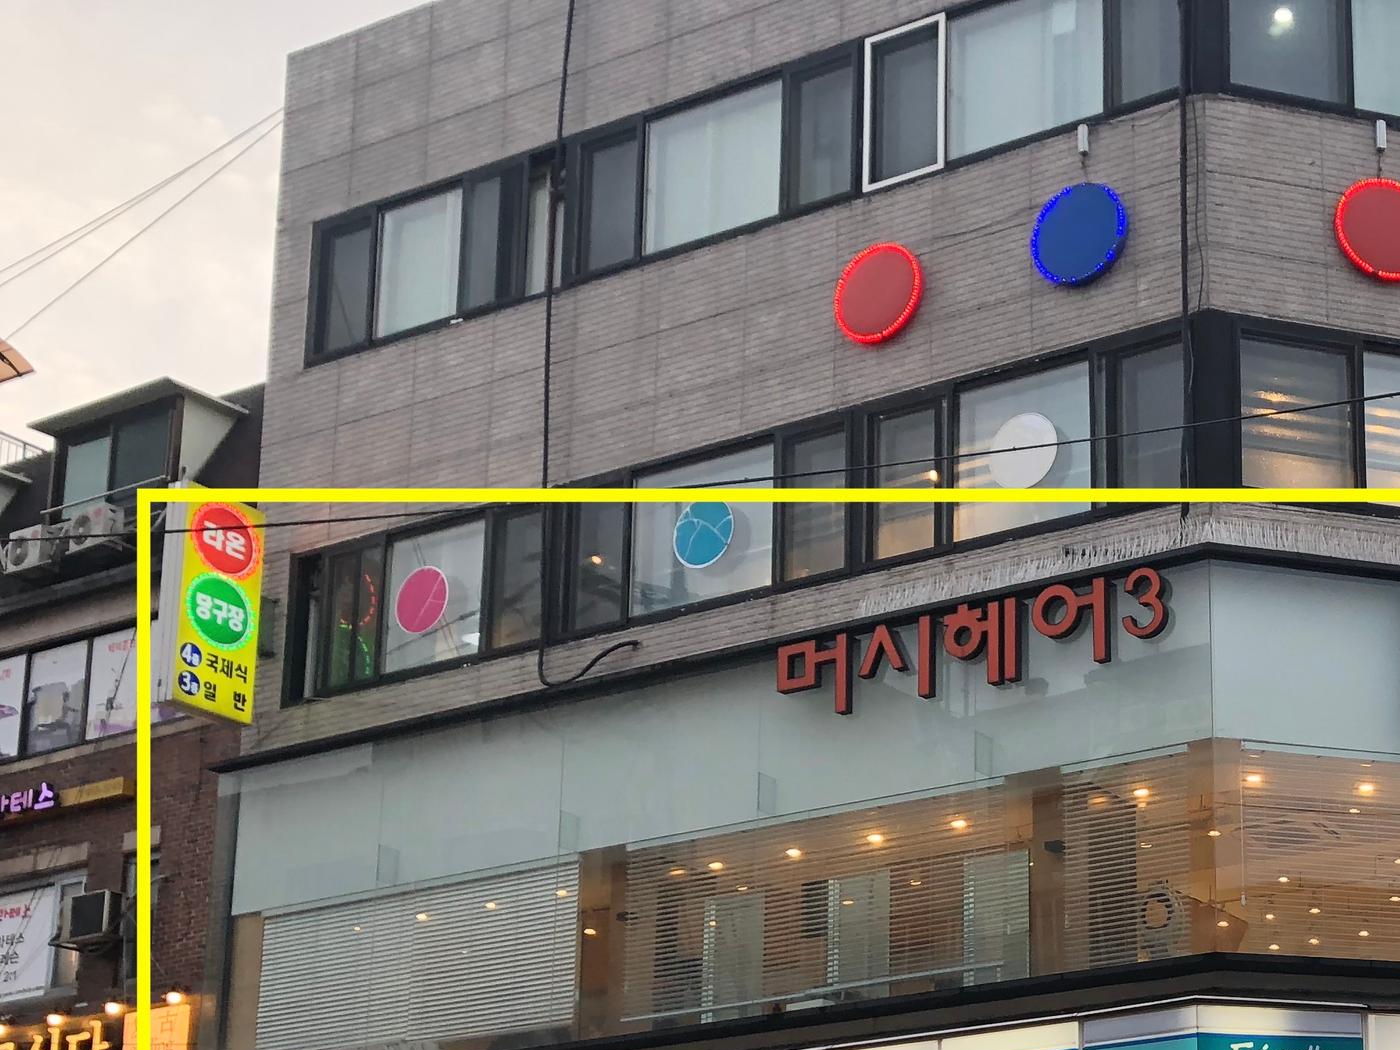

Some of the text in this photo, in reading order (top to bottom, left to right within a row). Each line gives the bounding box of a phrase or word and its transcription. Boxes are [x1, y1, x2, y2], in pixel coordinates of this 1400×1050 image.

[201, 524, 247, 560] 라온
[195, 591, 245, 633] 당구장
[776, 566, 1172, 715] 머시헤어3
[205, 652, 248, 684] 국제식
[0, 782, 54, 813] 테스
